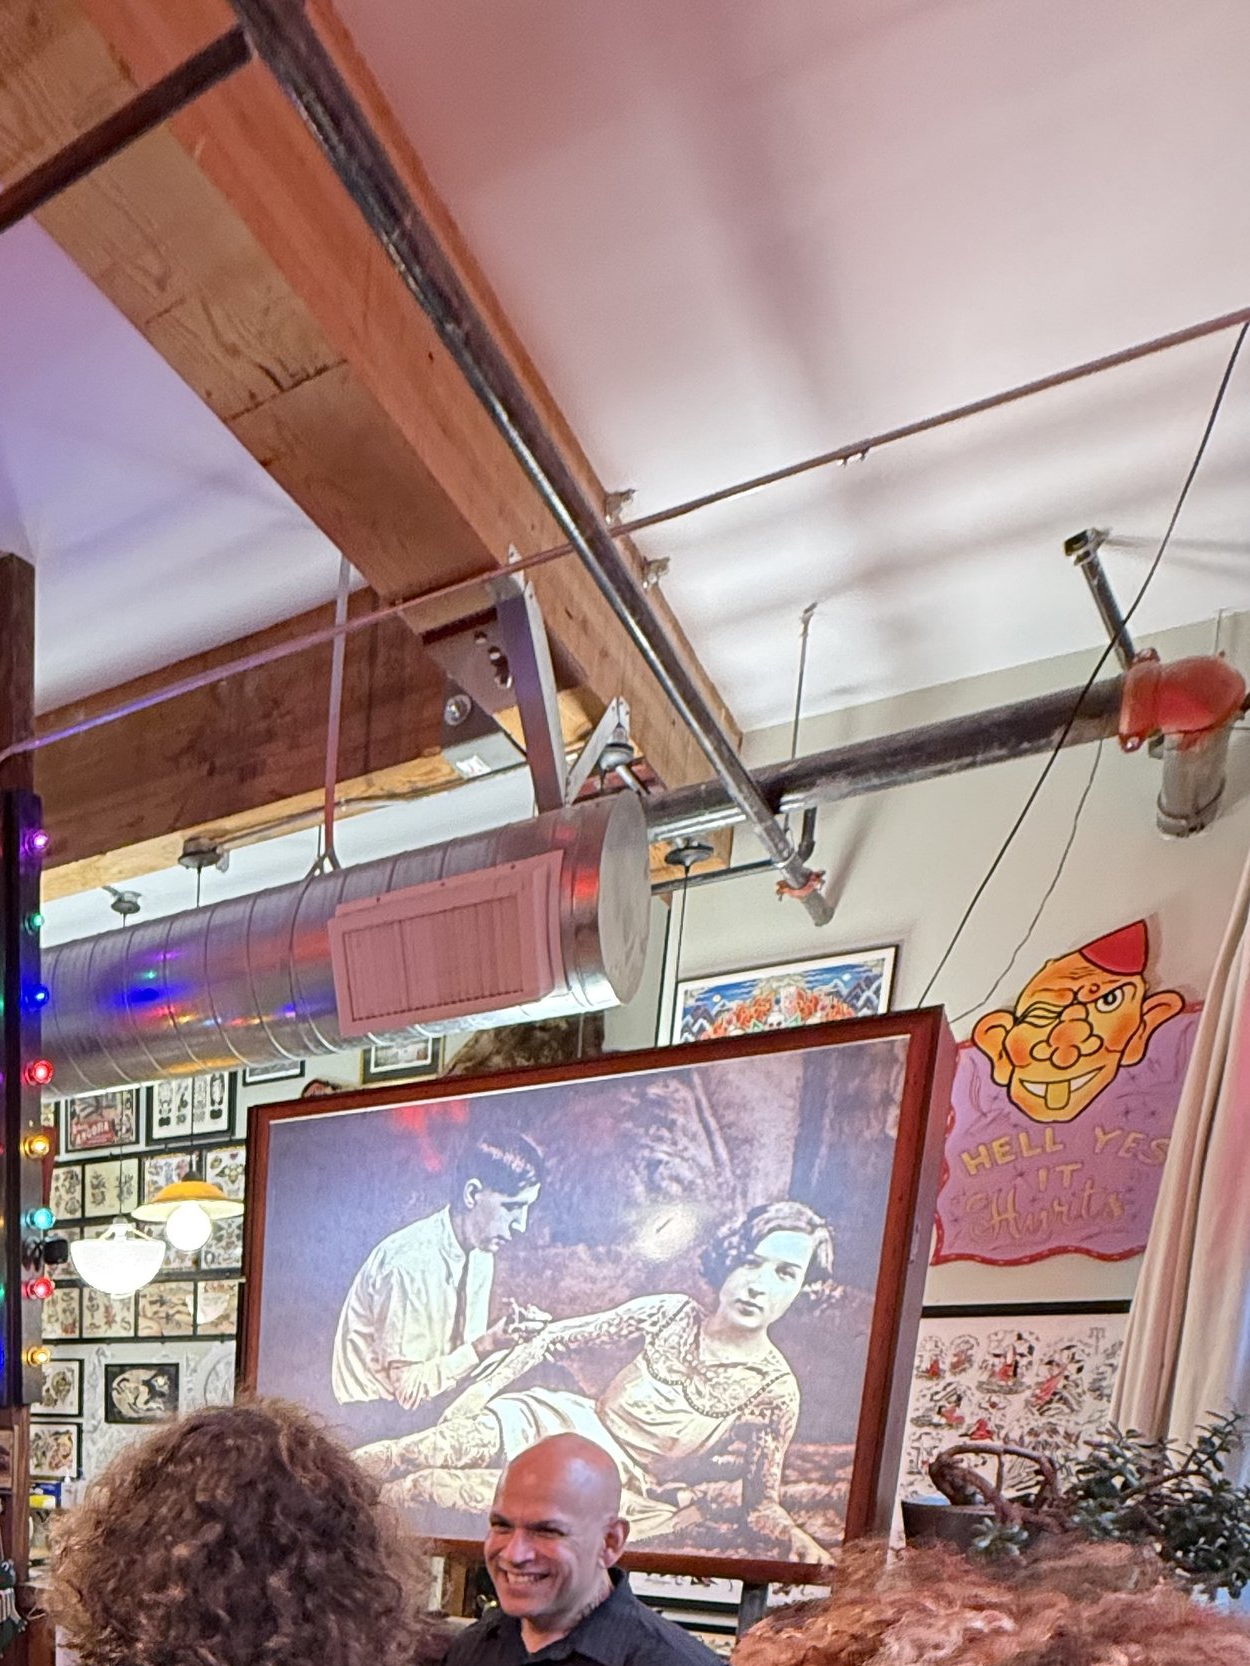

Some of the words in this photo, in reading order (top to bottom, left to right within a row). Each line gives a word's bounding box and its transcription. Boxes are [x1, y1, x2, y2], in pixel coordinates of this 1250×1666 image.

[961, 1127, 1065, 1177] HELL
[1094, 1125, 1171, 1167] YES
[1037, 1161, 1084, 1192] IT
